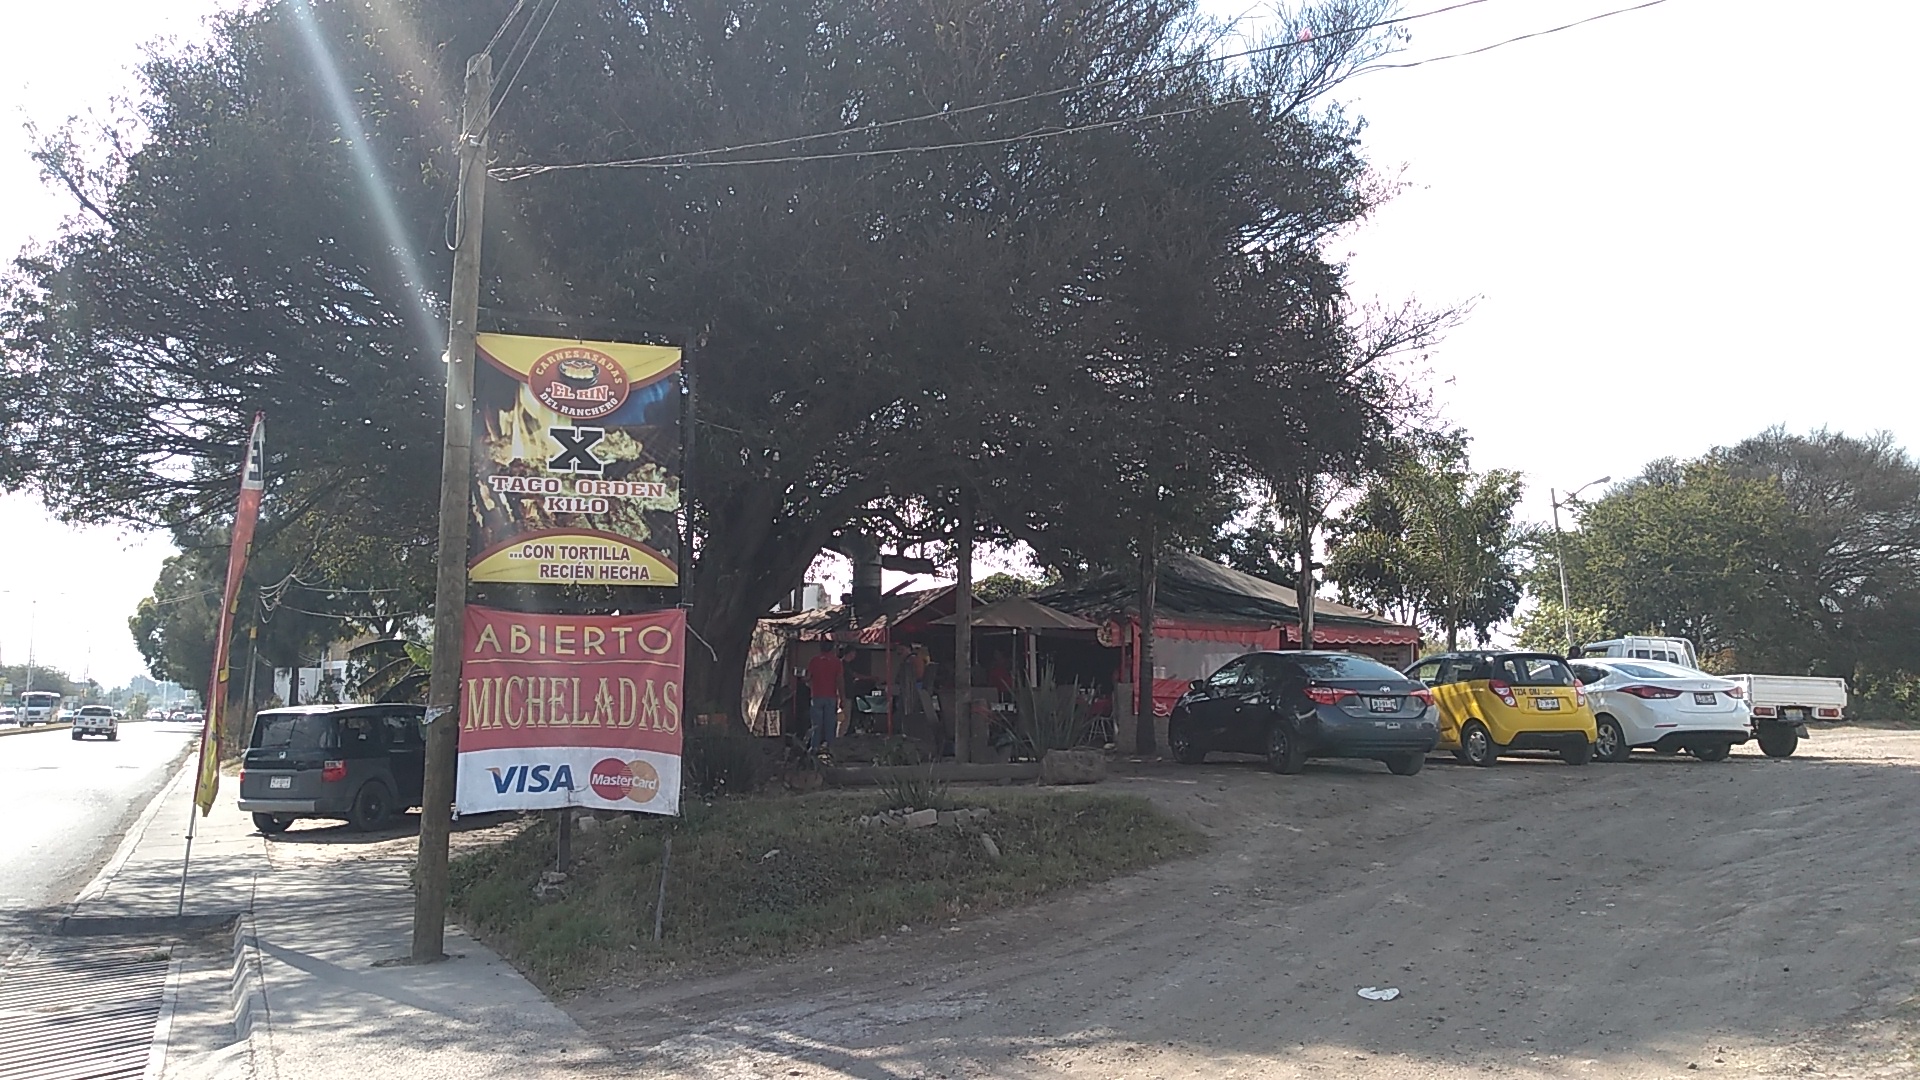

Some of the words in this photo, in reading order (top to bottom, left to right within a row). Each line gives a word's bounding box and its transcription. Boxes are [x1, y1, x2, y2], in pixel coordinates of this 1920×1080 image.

[536, 350, 580, 375] CARNES
[583, 351, 623, 384] ASADAS
[540, 392, 559, 410] DEL
[560, 398, 618, 416] RANCHERO
[549, 427, 604, 473] X
[491, 477, 560, 493] TACO
[578, 480, 663, 497] ORDEN
[547, 497, 607, 513] KILO
[559, 545, 630, 561] TORTILLA
[540, 562, 594, 579] RECIÉN
[600, 565, 650, 580] HECHA
[474, 623, 672, 655] ABIERTO
[464, 675, 679, 736] MICHELADAS
[486, 764, 575, 794] VISA
[591, 773, 657, 790] MasterCard
